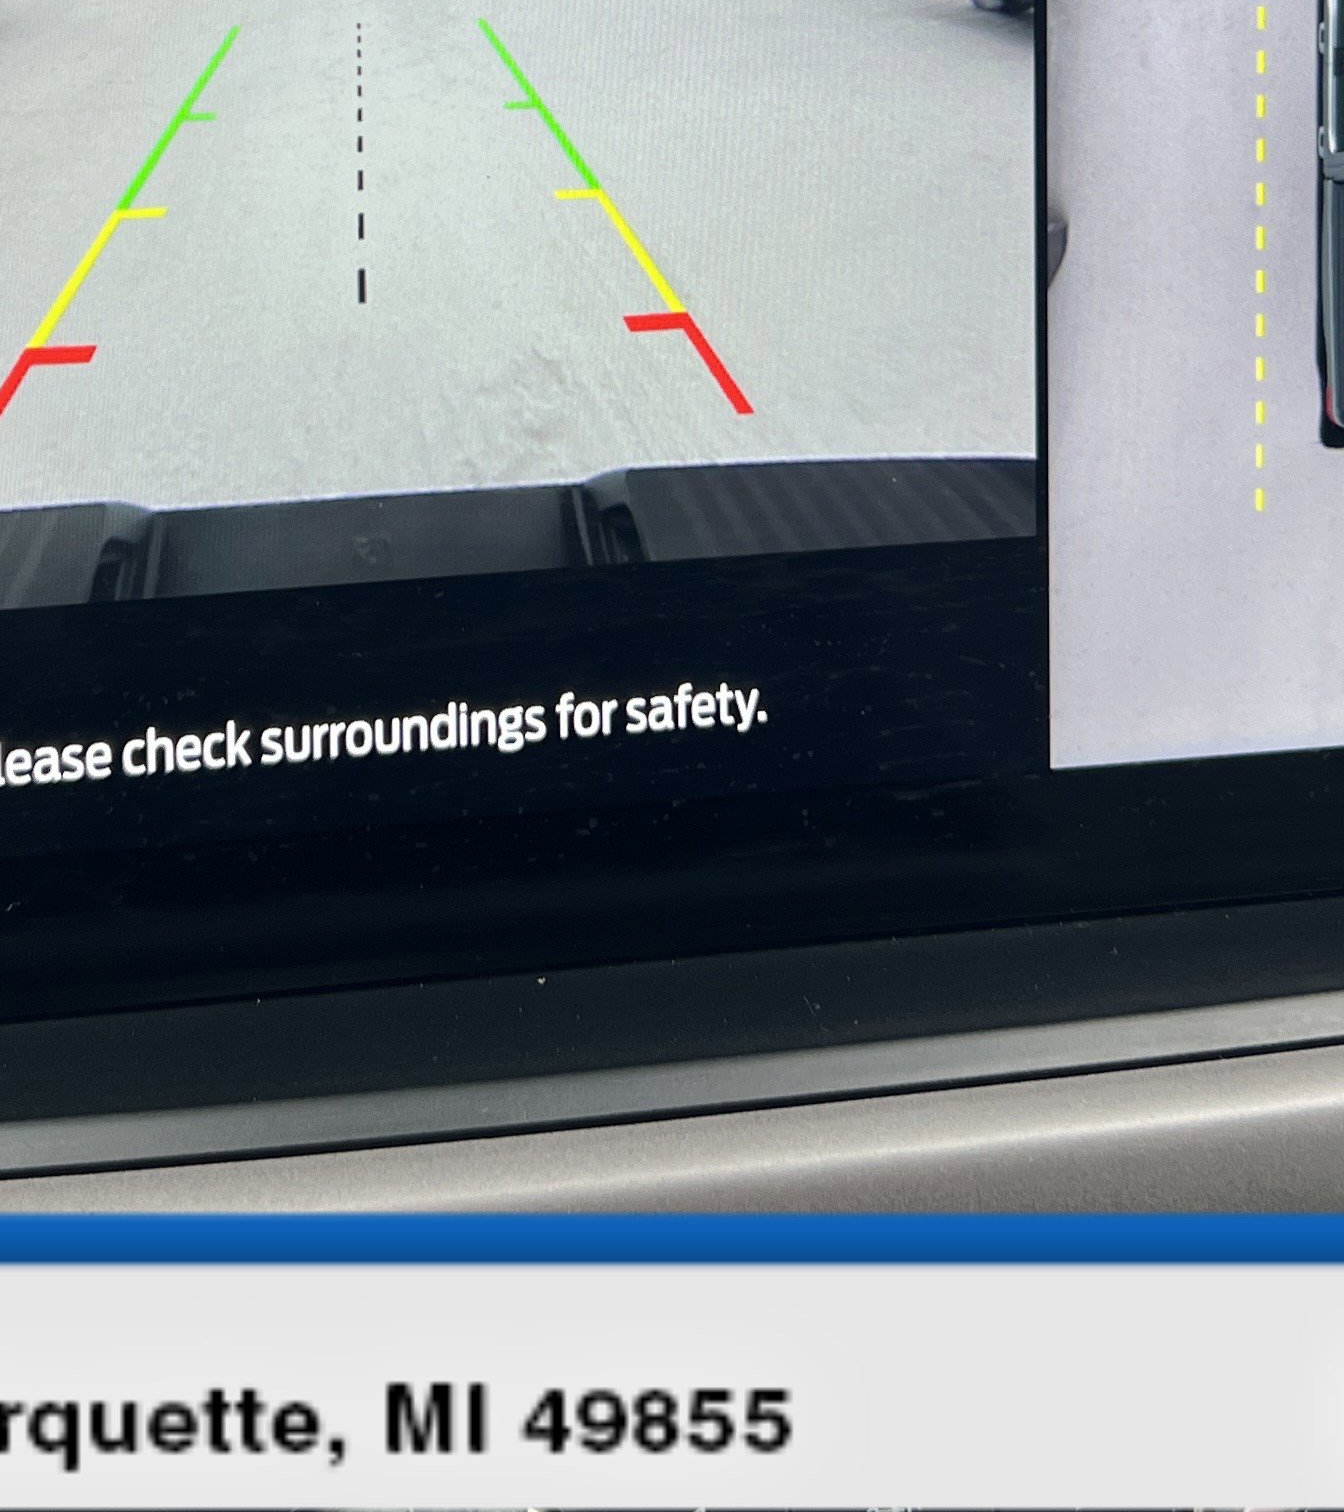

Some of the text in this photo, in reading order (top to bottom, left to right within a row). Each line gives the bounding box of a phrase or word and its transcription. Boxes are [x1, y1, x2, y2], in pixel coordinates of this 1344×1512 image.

[122, 719, 253, 777] check
[260, 701, 547, 765] surroundings
[555, 692, 618, 739] for
[626, 682, 769, 733] safety.
